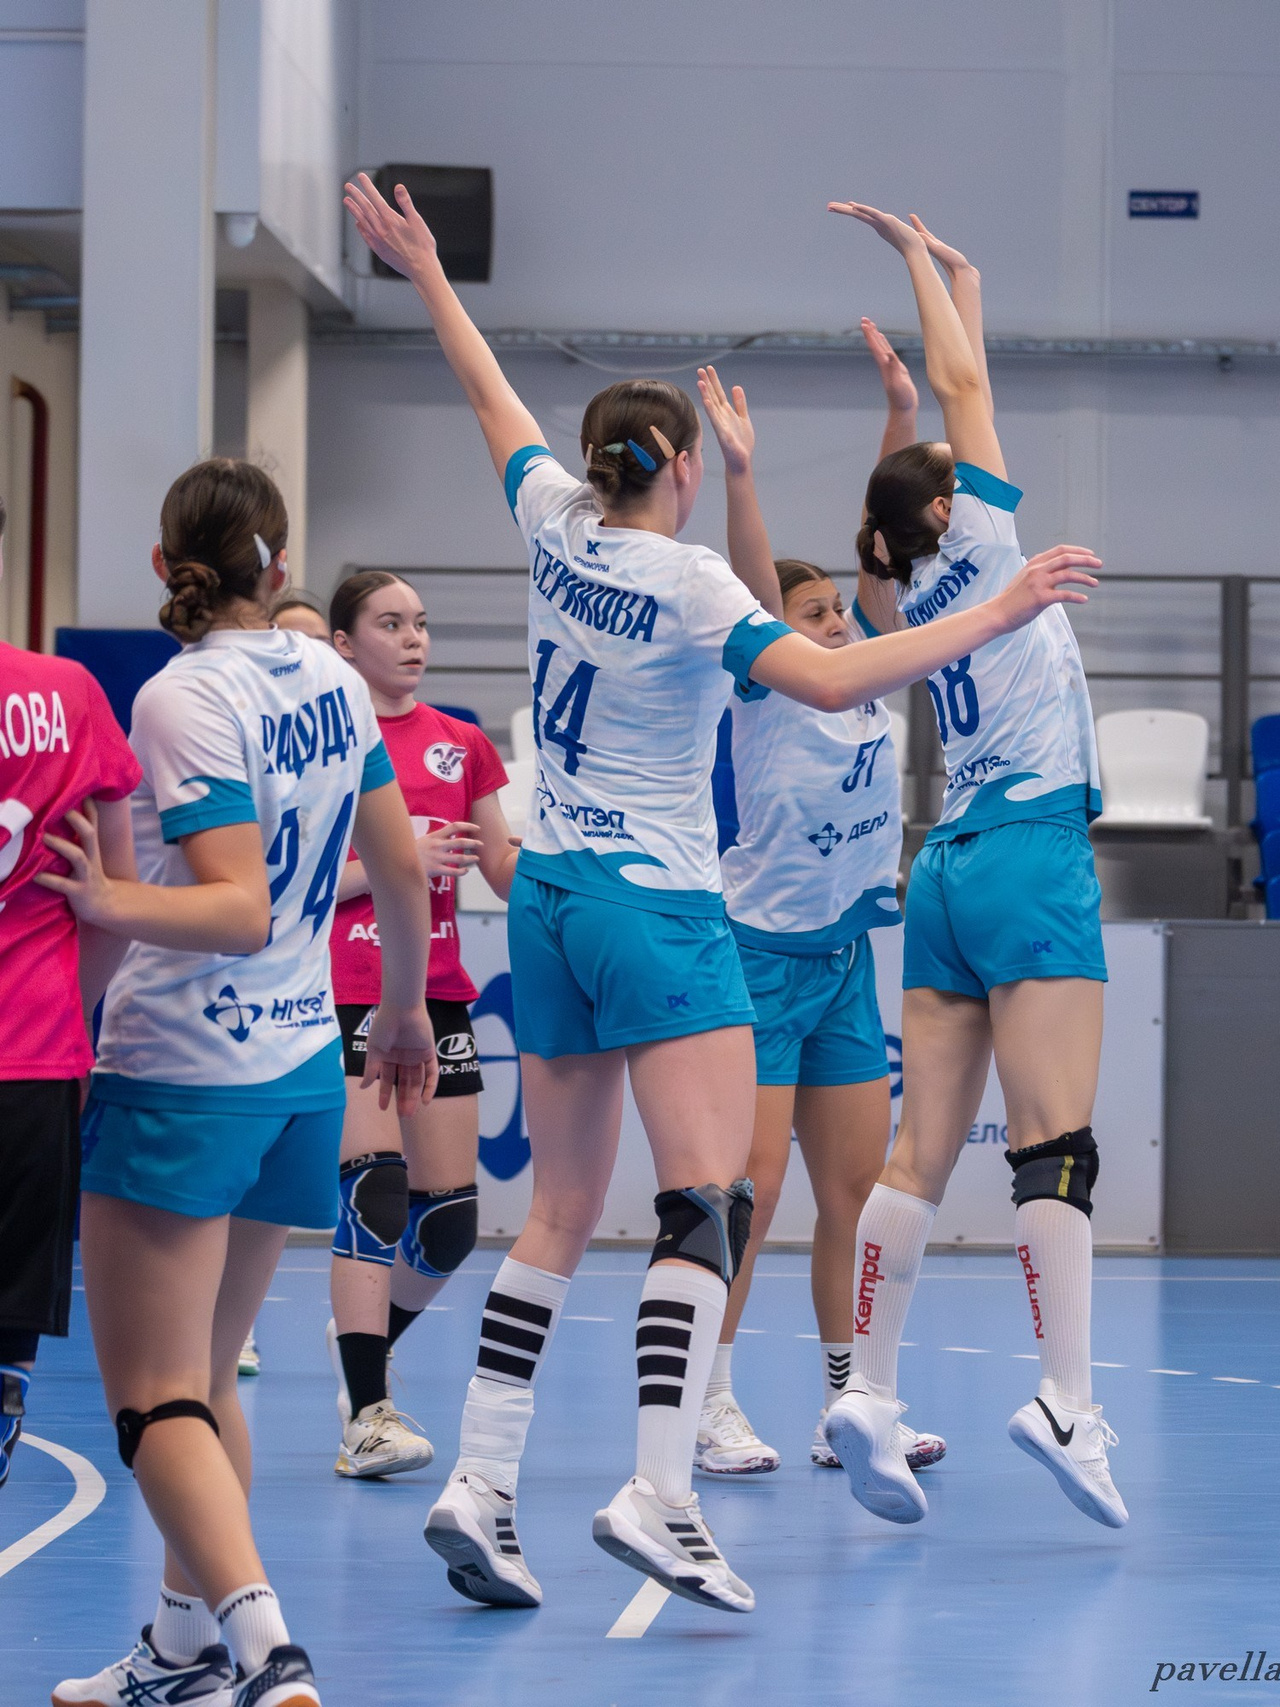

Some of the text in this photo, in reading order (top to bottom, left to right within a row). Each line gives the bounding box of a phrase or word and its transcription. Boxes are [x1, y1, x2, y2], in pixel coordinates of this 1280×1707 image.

[0, 691, 70, 760] ОВА
[533, 639, 602, 776] 14
[847, 811, 889, 844] ДЕЛО
[855, 1241, 886, 1337] Kempa
